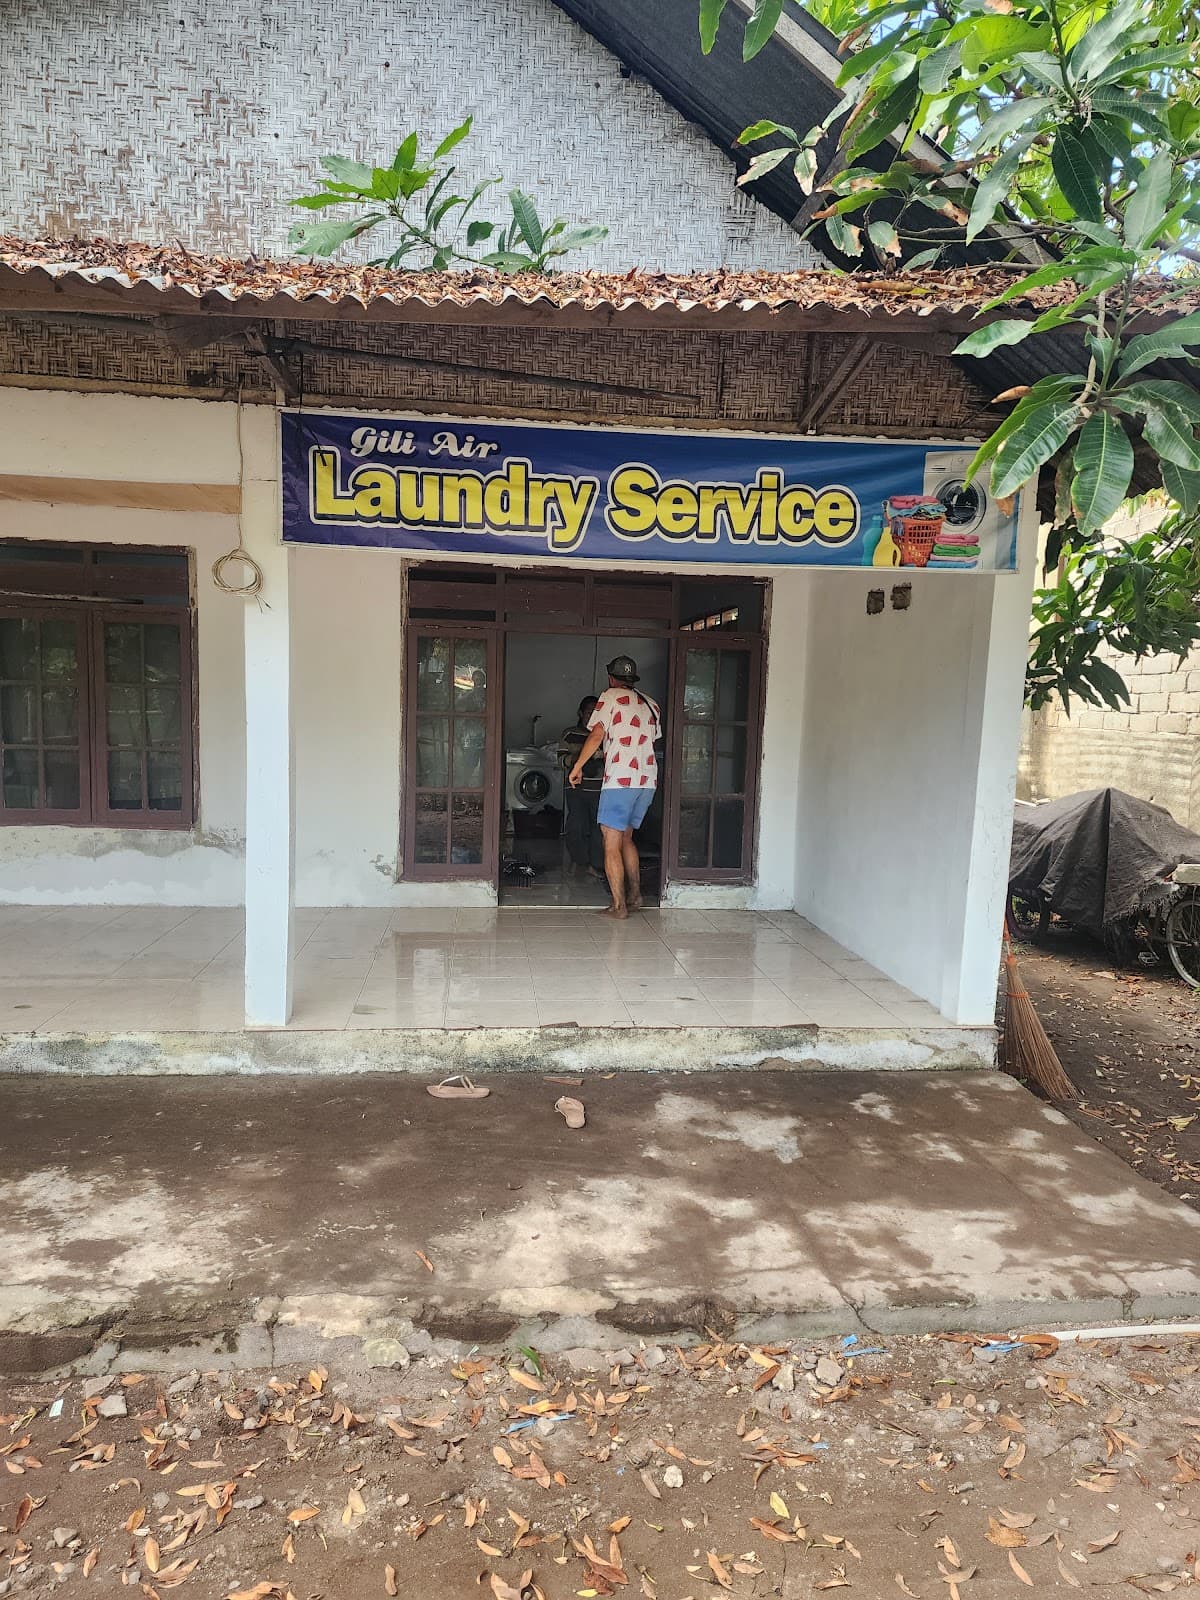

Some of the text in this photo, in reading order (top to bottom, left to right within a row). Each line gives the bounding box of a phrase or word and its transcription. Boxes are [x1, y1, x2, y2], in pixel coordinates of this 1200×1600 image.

[350, 426, 498, 459] Gili Air
[310, 446, 860, 552] Laundry Service
